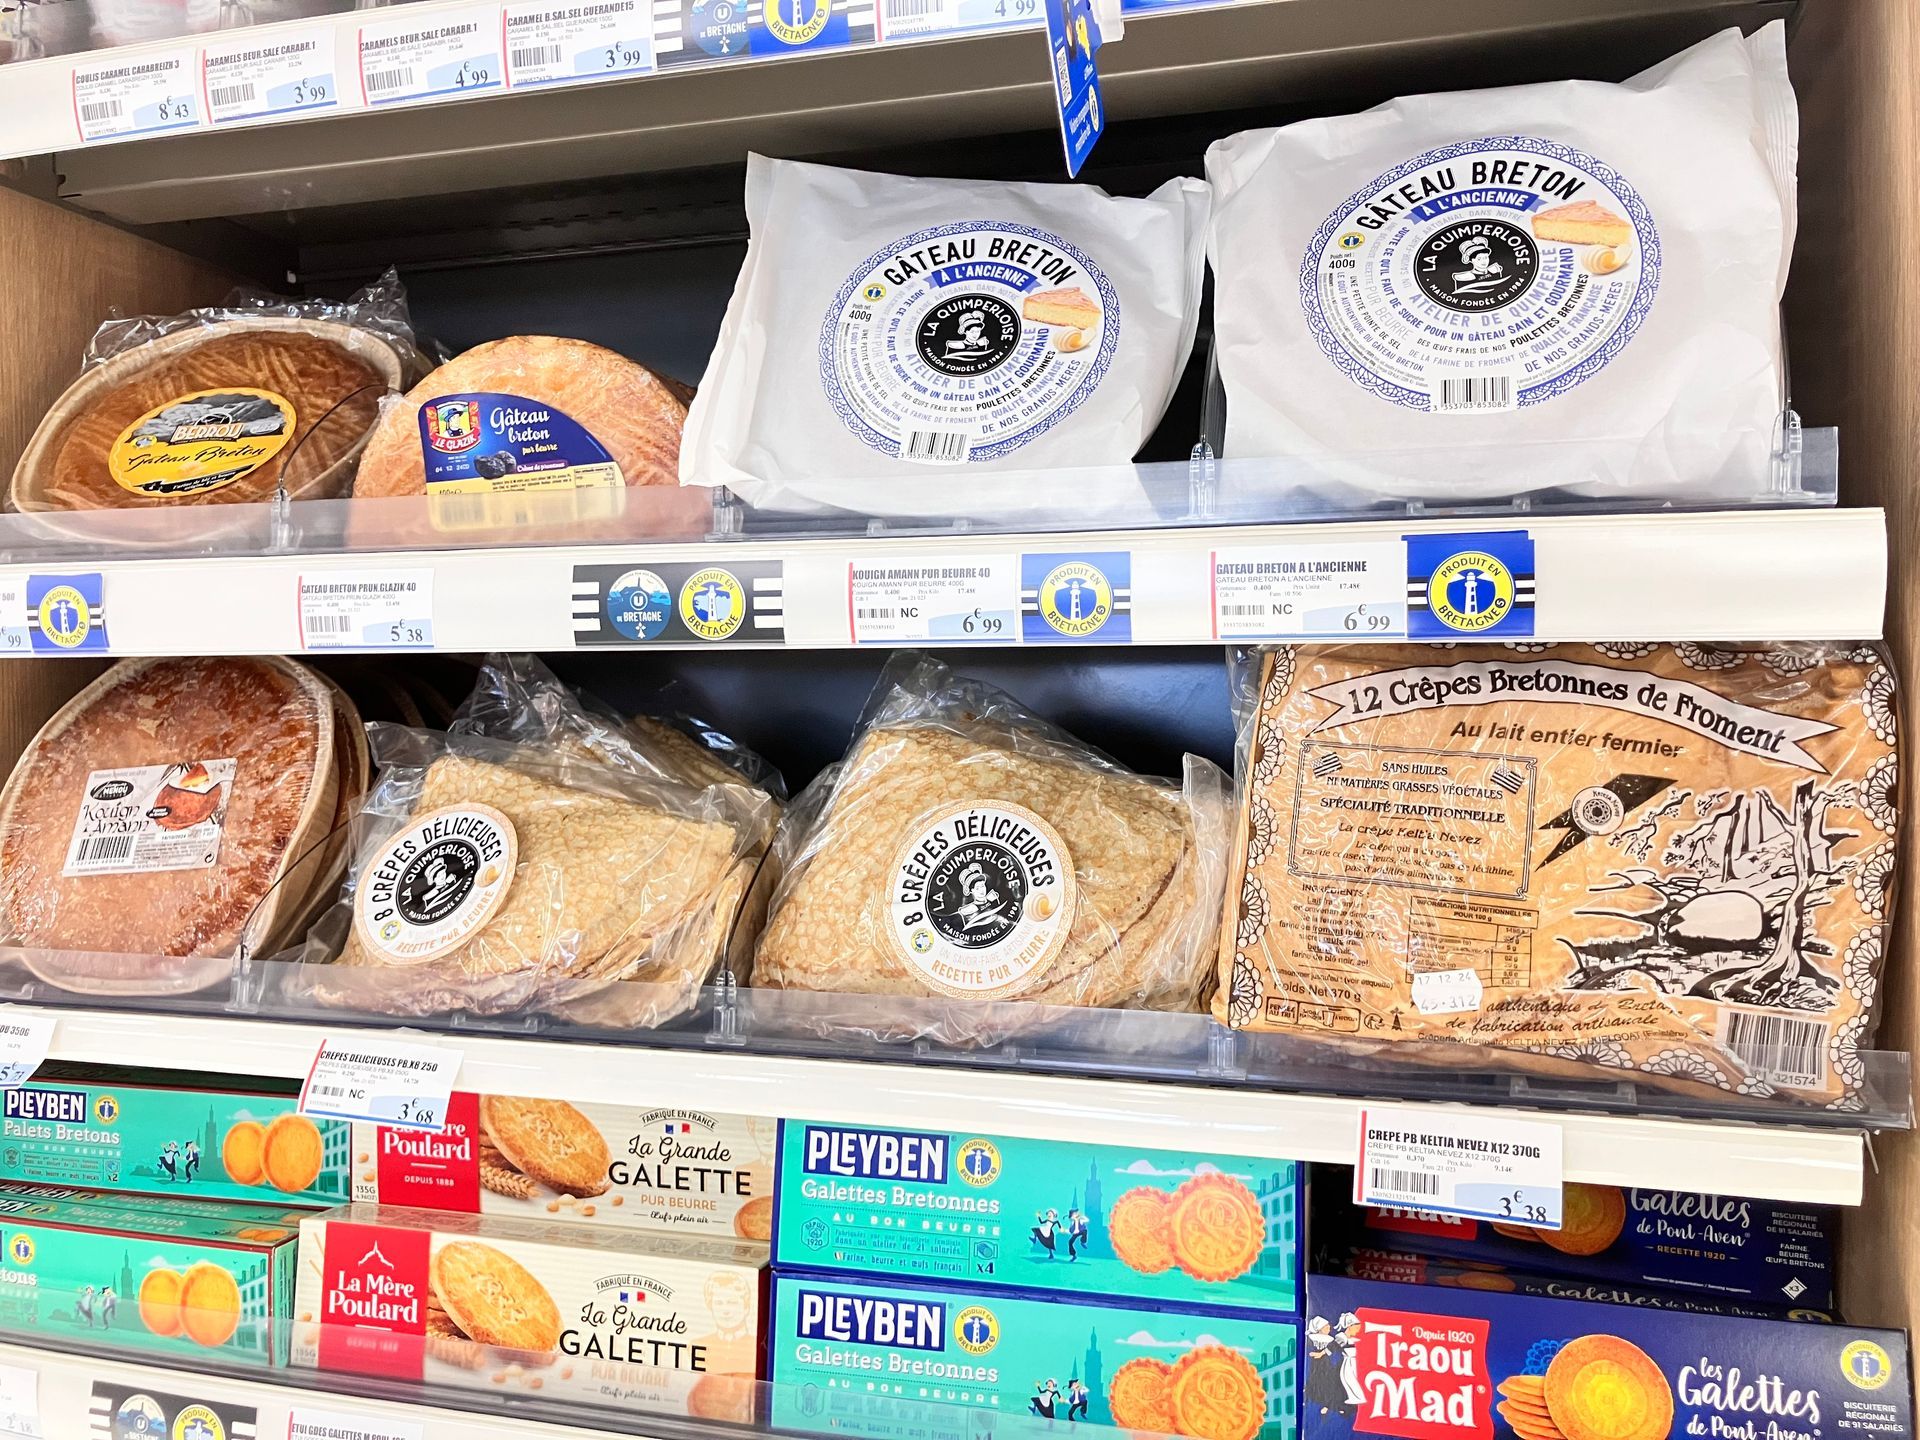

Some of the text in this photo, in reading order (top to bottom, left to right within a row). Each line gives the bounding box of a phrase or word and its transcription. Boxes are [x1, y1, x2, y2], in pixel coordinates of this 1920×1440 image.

[508, 14, 544, 27] CARAMEL
[707, 22, 747, 37] BRETAGNE
[772, 19, 821, 41] BRETAGNE
[360, 37, 398, 52] CARAMELS
[76, 60, 180, 83] COULIS CARAMEL CARABREIZH 3
[1356, 160, 1586, 230] GÂTEAU BRETON
[1438, 191, 1528, 212] L'ANCIENNE
[1422, 224, 1530, 272] LA QUIMPERLOISE
[884, 238, 1077, 286] GÂTEAU BRETON
[1328, 258, 1356, 271] 400g
[955, 264, 1029, 286] L'ANCIENNE
[1398, 308, 1424, 331] SUCRE
[1424, 324, 1448, 340] POUR
[1450, 332, 1464, 341] UN
[1508, 318, 1534, 335] SAIN
[1534, 306, 1549, 318] ET
[1545, 248, 1574, 306] GOURMAND
[848, 311, 872, 322] 400g
[923, 299, 1015, 342] LA QUIMPERLOISE
[1408, 293, 1471, 328] ATELIER
[1482, 313, 1502, 326] DE
[1510, 273, 1588, 348] POULETTES BRETONNES
[490, 407, 551, 435] Gâteau
[435, 434, 477, 451] LE GLAZIK
[508, 427, 550, 443] breton
[522, 446, 534, 455] pur
[852, 568, 990, 580] KOUIGN AMANN PUR BEURRE 40
[1050, 568, 1102, 586] PRODUIT EN
[1216, 560, 1367, 574] GATEAU BRETON A L'ANCIENNE
[1441, 556, 1502, 578] PRODUIT EN
[301, 583, 327, 594] GATEAU
[329, 583, 356, 593] BRETON
[407, 582, 416, 591] 40
[689, 573, 734, 591] PRODUIT EN
[624, 612, 662, 622] BRETAGNE
[900, 608, 918, 618] NC
[1272, 604, 1292, 614] NC
[1438, 605, 1500, 627] BRETAGNE
[688, 614, 738, 636] BRETAGNE
[1048, 610, 1101, 633] BRETAGNE
[1350, 669, 1786, 753] 12 Crêpes Bretonnes de Froment
[1450, 722, 1684, 757] Au lait entier fermier
[1382, 762, 1448, 776] SANS HUILES
[1340, 776, 1390, 791] MATIÈRES
[1392, 780, 1438, 794] GRASSES
[1320, 797, 1505, 823] SPÉCIALITÉ TRADITIONNELLE
[372, 818, 502, 921] 8 CRÊPES DÉLICIEUSES
[401, 844, 474, 905] LA QUIMPERLOISE
[901, 810, 1055, 926] 8 CRÊPES DÉLICIEUSES
[932, 848, 1020, 912] LA QUIMPERLOISE
[1472, 1016, 1564, 1036] fabrication
[320, 1050, 348, 1062] CREPES
[350, 1053, 396, 1067] DELICIEUSES
[421, 1061, 438, 1072] 250
[1774, 1072, 1816, 1086] 321574
[349, 1089, 365, 1099] NC
[5, 1090, 84, 1121] PLEYBEN
[642, 1108, 717, 1130] FABRIQUÉ EN FRANCE
[4, 1122, 120, 1144] Palets Bretons
[1368, 1130, 1540, 1158] CREPE PB KELTIA NEVEZ X12 370G
[384, 1132, 472, 1160] Poulard
[628, 1134, 732, 1163] La Grande
[809, 1129, 944, 1181] PLEYBEN
[609, 1161, 752, 1196] GALETTE
[640, 1194, 716, 1212] PUR BEURRE
[801, 1180, 999, 1214] Galettes Bretonnes
[1632, 1186, 1751, 1226] Galettes
[1657, 1244, 1725, 1261] RECETTE 1920
[338, 1271, 414, 1298] La Mère
[329, 1291, 418, 1324] Poulard
[581, 1302, 686, 1335] La Grande
[803, 1294, 941, 1348] PLEYBEN
[1412, 1326, 1474, 1344] Depuis 1920
[560, 1330, 707, 1372] GALETTE
[1365, 1322, 1473, 1376] Traou
[795, 1344, 999, 1382] Galettes Bretonnes
[1700, 1357, 1722, 1382] les
[1364, 1371, 1478, 1428] Mad
[1678, 1358, 1820, 1423] Galettes
[1843, 1401, 1898, 1414] BISCUITERIE
[292, 1424, 362, 1440] ETUI GDES GALETTES
[1688, 1417, 1706, 1435] de
